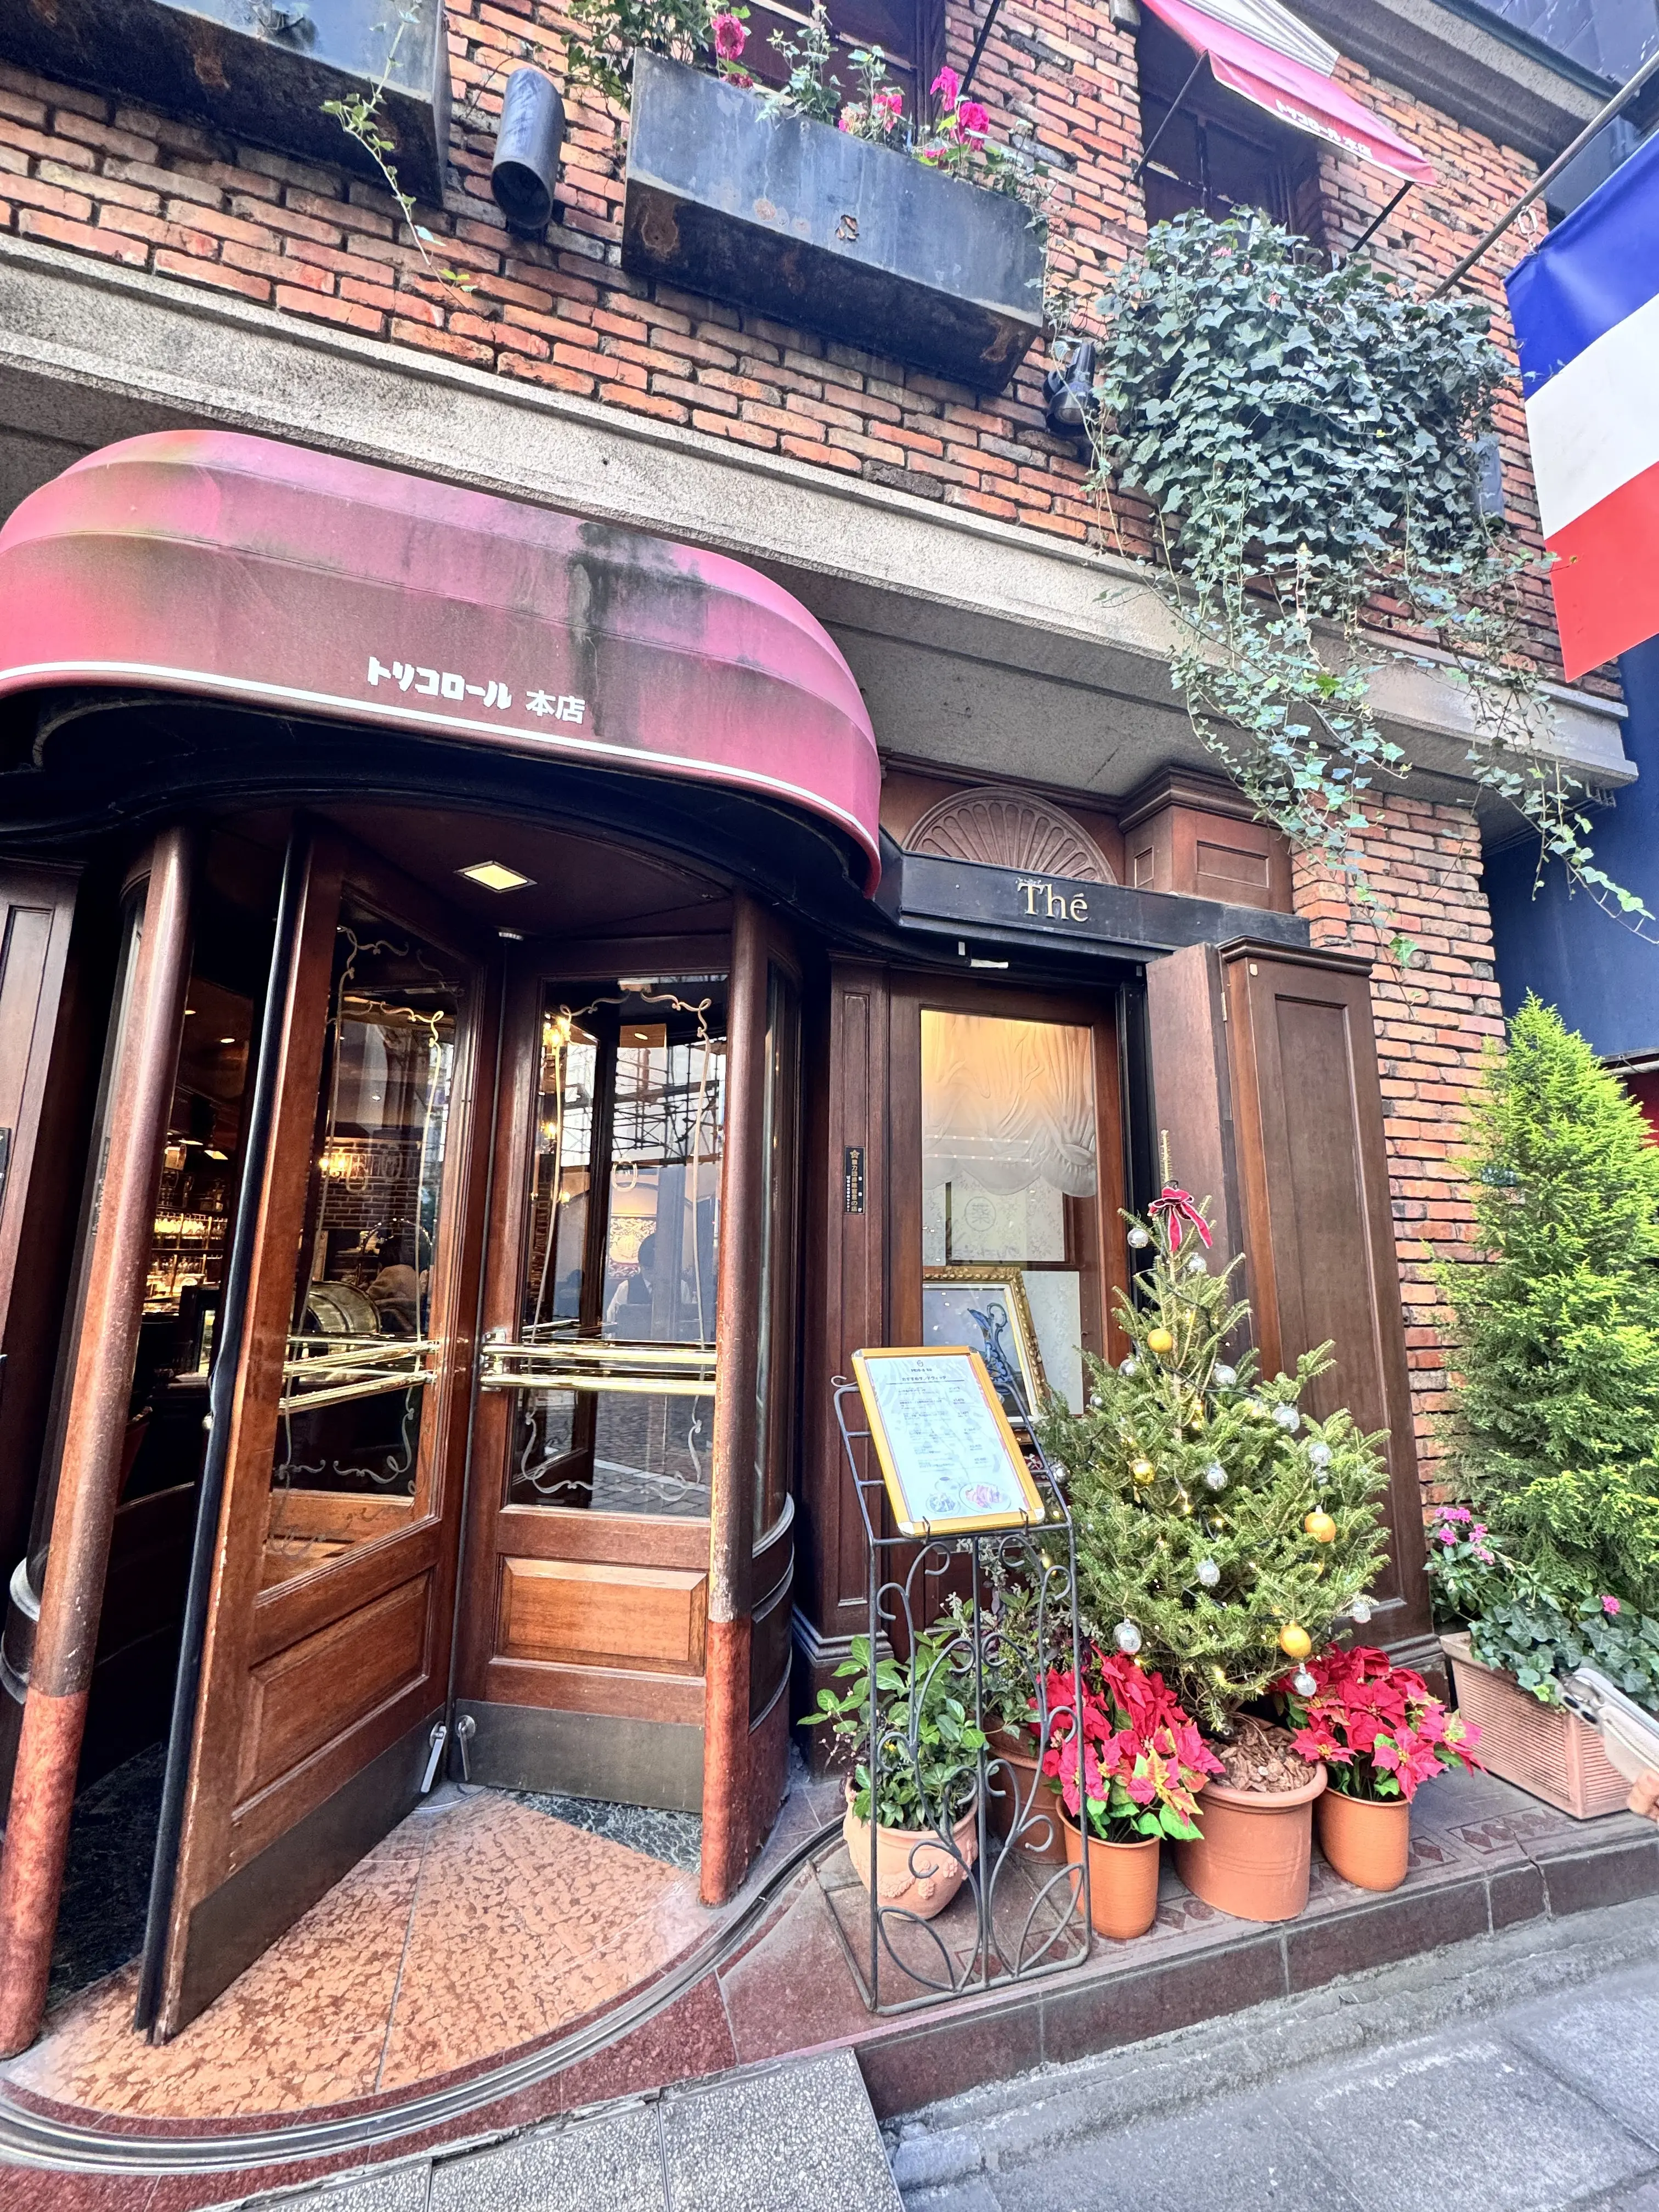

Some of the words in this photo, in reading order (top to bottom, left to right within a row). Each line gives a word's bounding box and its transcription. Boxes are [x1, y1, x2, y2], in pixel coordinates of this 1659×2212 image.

[1275, 99, 1341, 142] トリコロール
[367, 656, 512, 710] トリコロール
[525, 690, 585, 724] 本店
[1017, 882, 1088, 922] Thé
